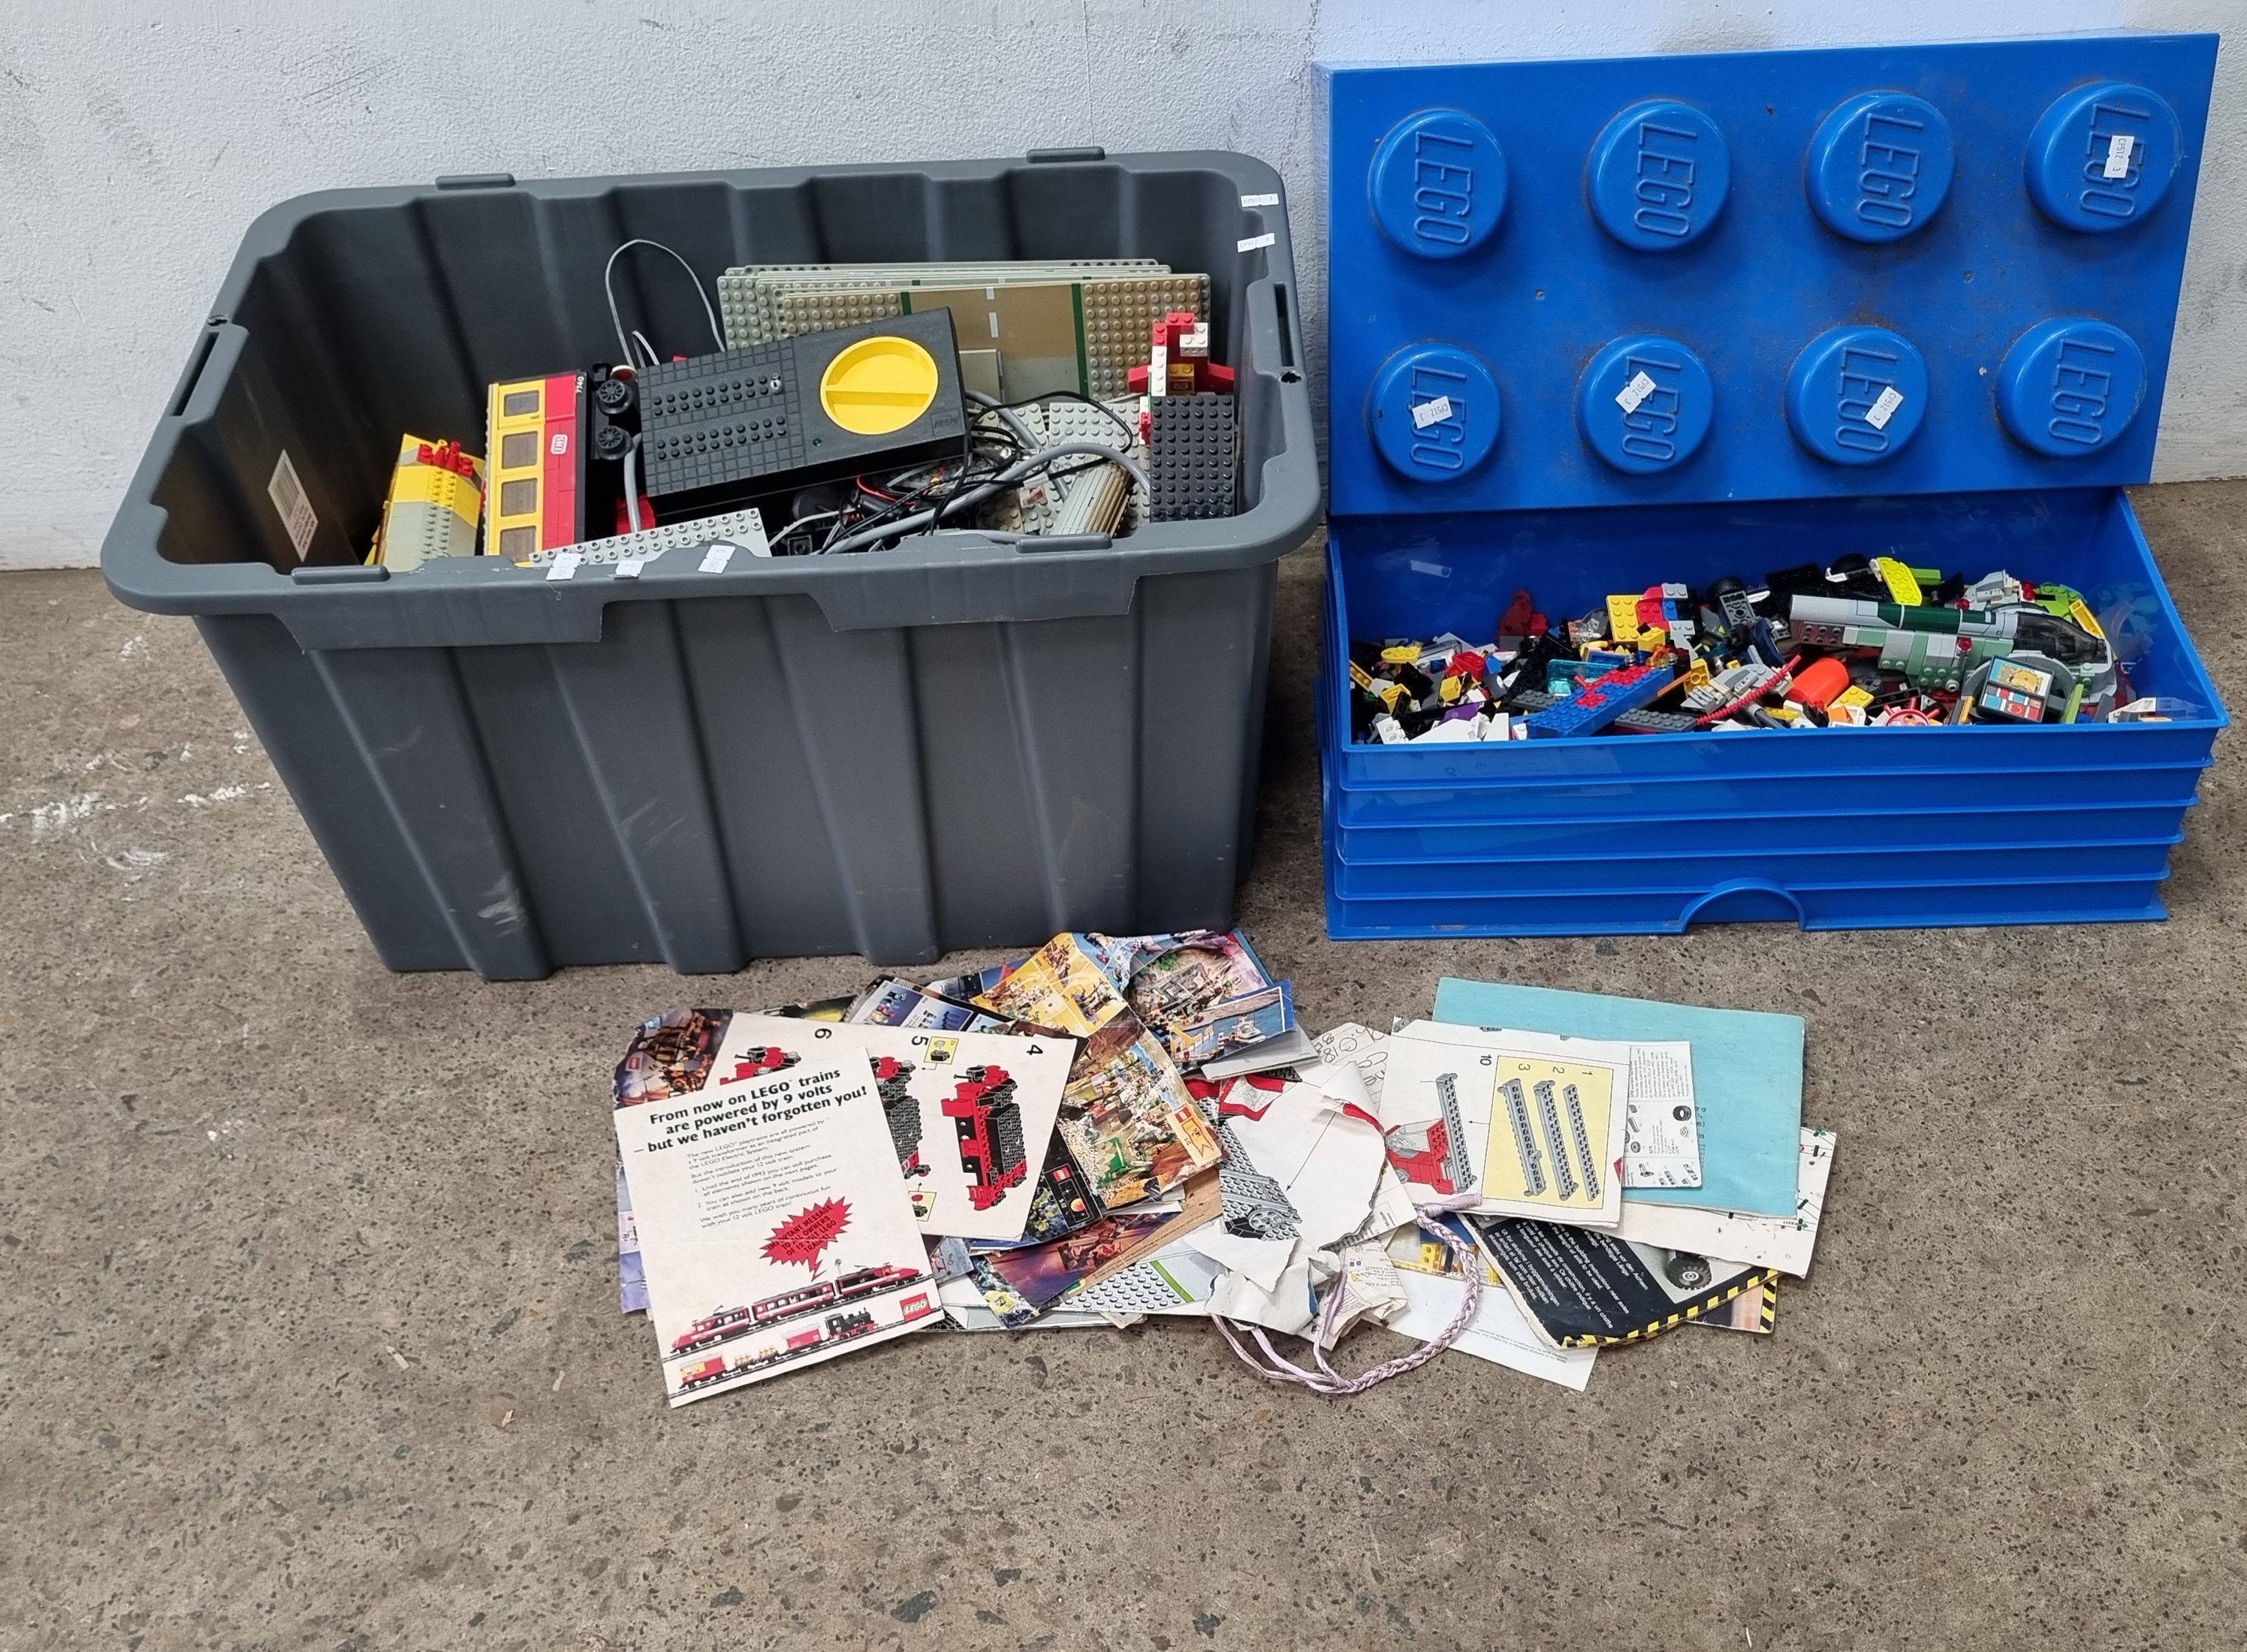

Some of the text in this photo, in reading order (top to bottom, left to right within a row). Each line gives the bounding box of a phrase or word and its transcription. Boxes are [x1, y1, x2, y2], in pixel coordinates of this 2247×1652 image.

[2114, 138, 2127, 159] CF512
[1635, 122, 1698, 237] LEGO
[1857, 113, 1924, 228] LEGO
[1415, 130, 1473, 246] LEGO
[576, 375, 585, 394] 7740
[1631, 378, 1649, 396] CF512
[2049, 339, 2115, 445] LEGO
[1419, 403, 1449, 421] CF512 3
[1880, 392, 1897, 411] CF512
[814, 1027, 832, 1040] 6
[911, 1035, 929, 1046] 5
[1026, 1044, 1044, 1056] 4
[1479, 1054, 1493, 1066] 10
[1518, 1063, 1531, 1072] 3
[1552, 1066, 1565, 1075] 2
[650, 1070, 840, 1124] From now on LEGO trains
[647, 1086, 867, 1152] but we haven't forgotten you!
[666, 1085, 832, 1134] are powered by 9 volts
[802, 1204, 833, 1226] MESSAGE
[780, 1242, 792, 1250] TO
[801, 1215, 831, 1236] OWNERS
[786, 1247, 795, 1256] OF
[795, 1242, 805, 1250] 12
[819, 1219, 837, 1234] LEGO
[1552, 1226, 1560, 1234] the
[1558, 1234, 1571, 1250] length
[1573, 1254, 1583, 1264] axle
[1567, 1237, 1576, 1245] the
[1574, 1244, 1591, 1265] building
[1588, 1263, 1611, 1290] instructions
[1609, 1290, 1620, 1301] near
[1618, 1301, 1630, 1314] axles
[903, 1299, 927, 1316] LEGO
